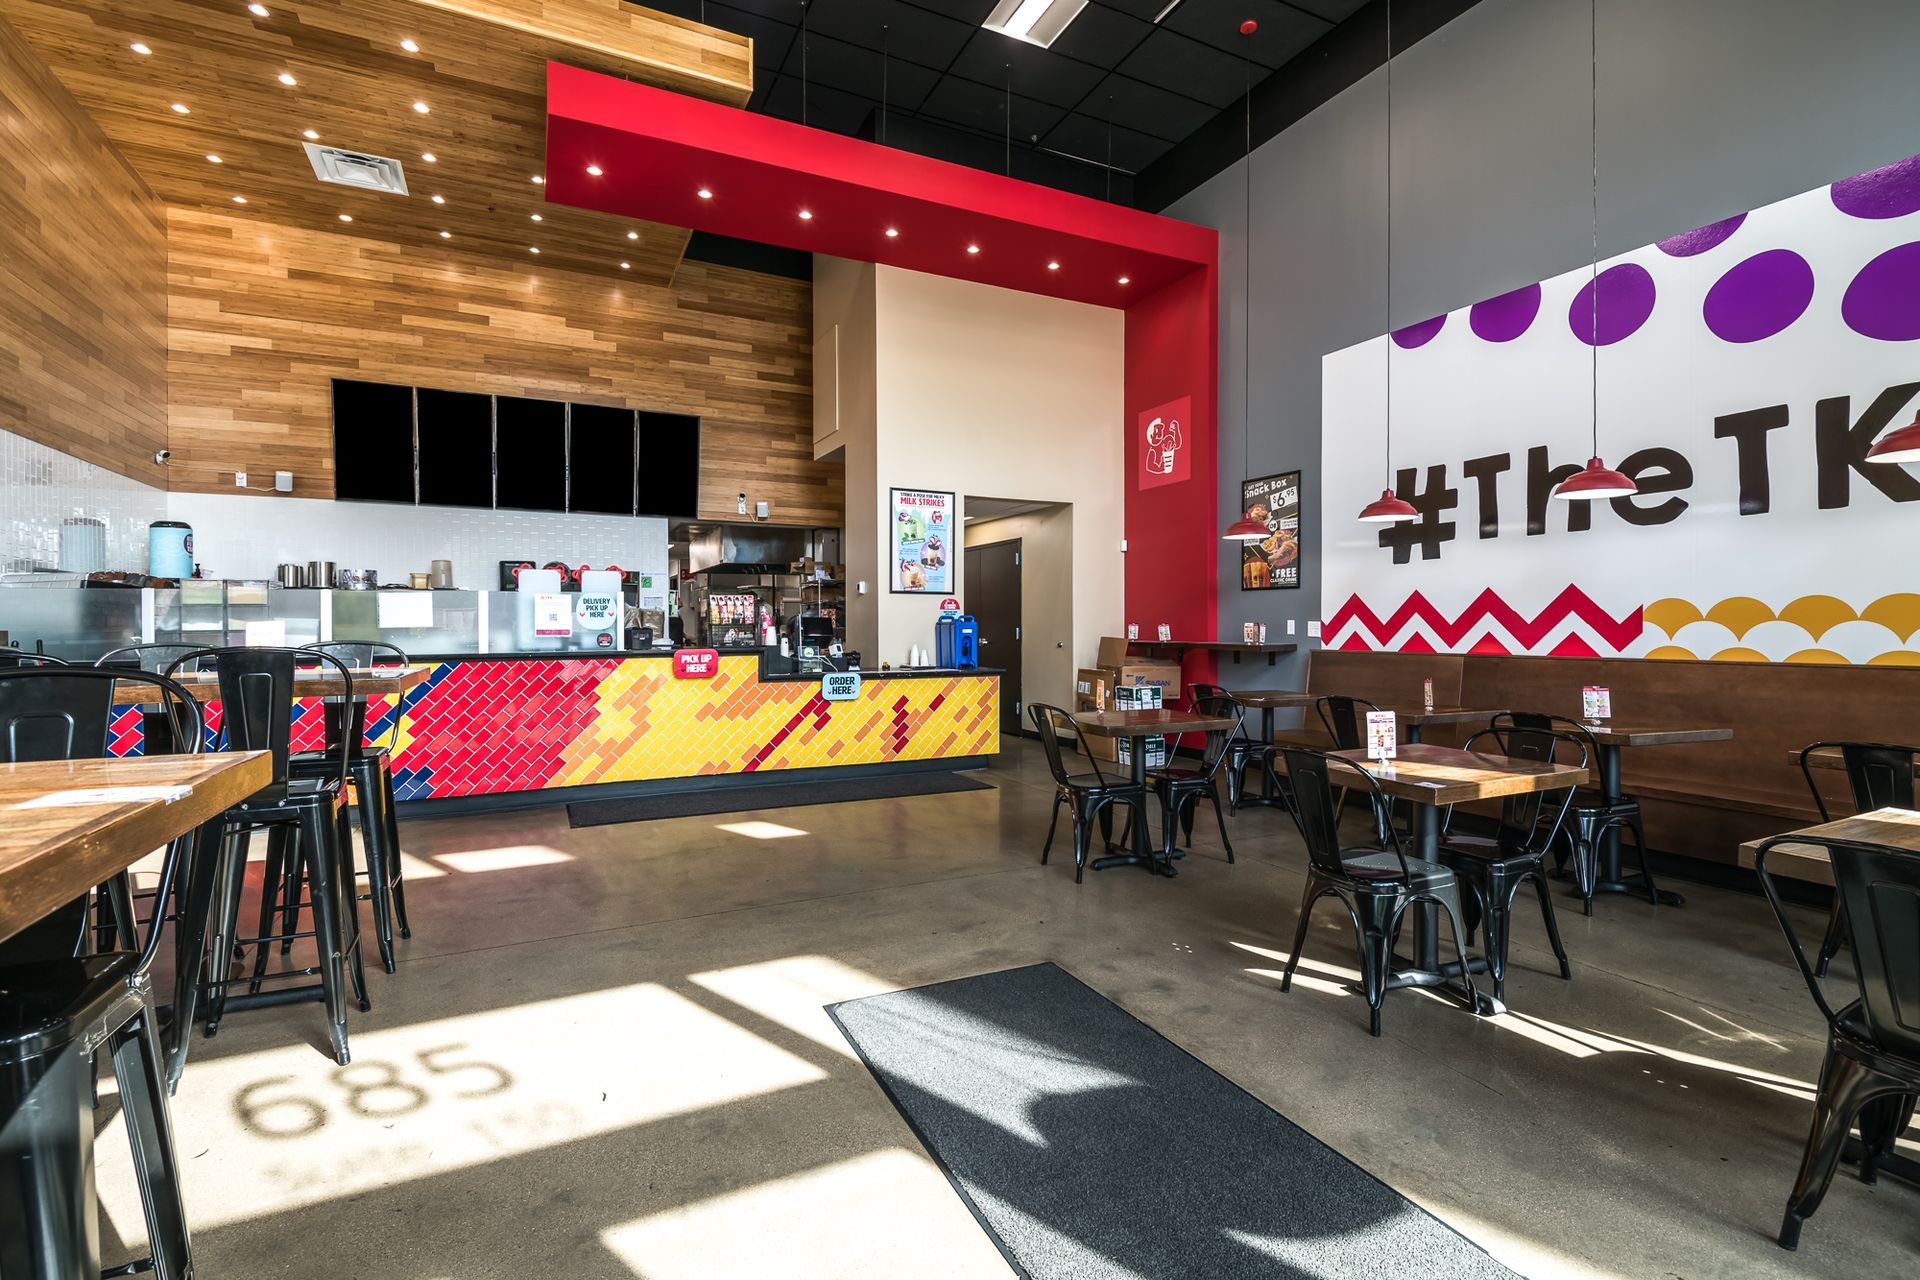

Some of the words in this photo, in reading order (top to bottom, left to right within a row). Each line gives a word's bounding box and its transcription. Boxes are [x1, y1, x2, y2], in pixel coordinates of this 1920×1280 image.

[900, 497, 917, 505] MILK
[919, 498, 945, 507] STRIKES
[1276, 567, 1297, 578] FREE
[681, 654, 700, 664] PICK
[700, 654, 713, 663] UP
[686, 664, 707, 673] HERE
[829, 676, 855, 686] ORDER
[832, 686, 852, 695] HERE
[231, 1041, 516, 1141] 685
